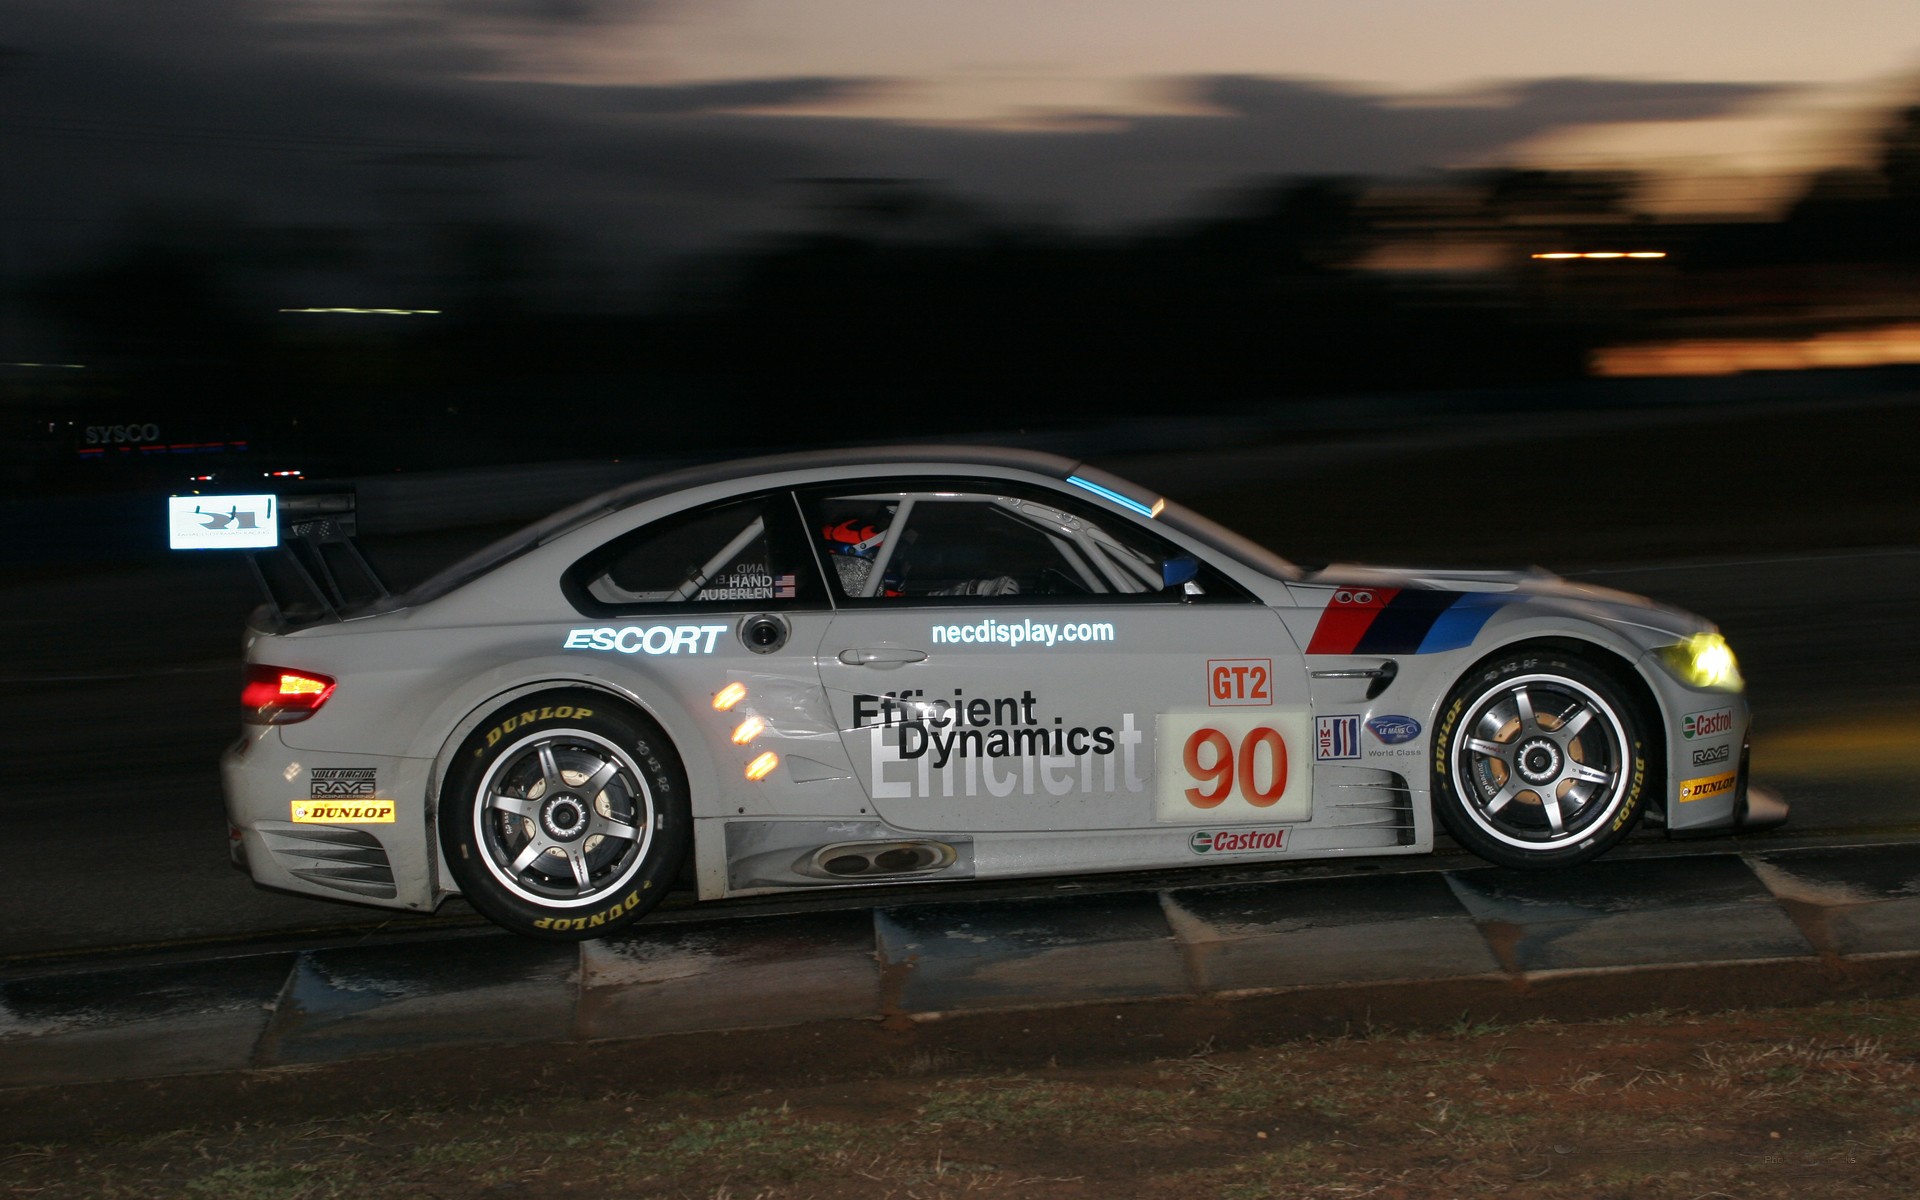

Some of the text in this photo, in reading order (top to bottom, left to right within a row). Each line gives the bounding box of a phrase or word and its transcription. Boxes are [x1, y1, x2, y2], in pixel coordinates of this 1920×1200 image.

[85, 423, 160, 444] SYSCO
[698, 587, 773, 601] AUBERLEN
[729, 575, 773, 588] HAND
[563, 625, 728, 655] ESCORT
[932, 619, 1114, 647] necdisplay.com
[1212, 666, 1268, 700] GT2
[853, 688, 1037, 729] Efficient
[1696, 710, 1732, 736] Castrol
[484, 705, 594, 748] DUNLOP
[1320, 719, 1331, 757] IMSA
[1436, 698, 1463, 775] DUNLOP
[898, 717, 1116, 769] Dynamics
[1693, 745, 1729, 763] RAYS
[1182, 726, 1288, 810] 90
[312, 782, 375, 795] RAYS
[1612, 755, 1645, 832] DUNLOP
[1692, 776, 1735, 796] DUNLOP
[311, 807, 391, 819] DUNLOP
[1213, 829, 1284, 851] Castrol
[534, 891, 642, 932] DUNLOP
